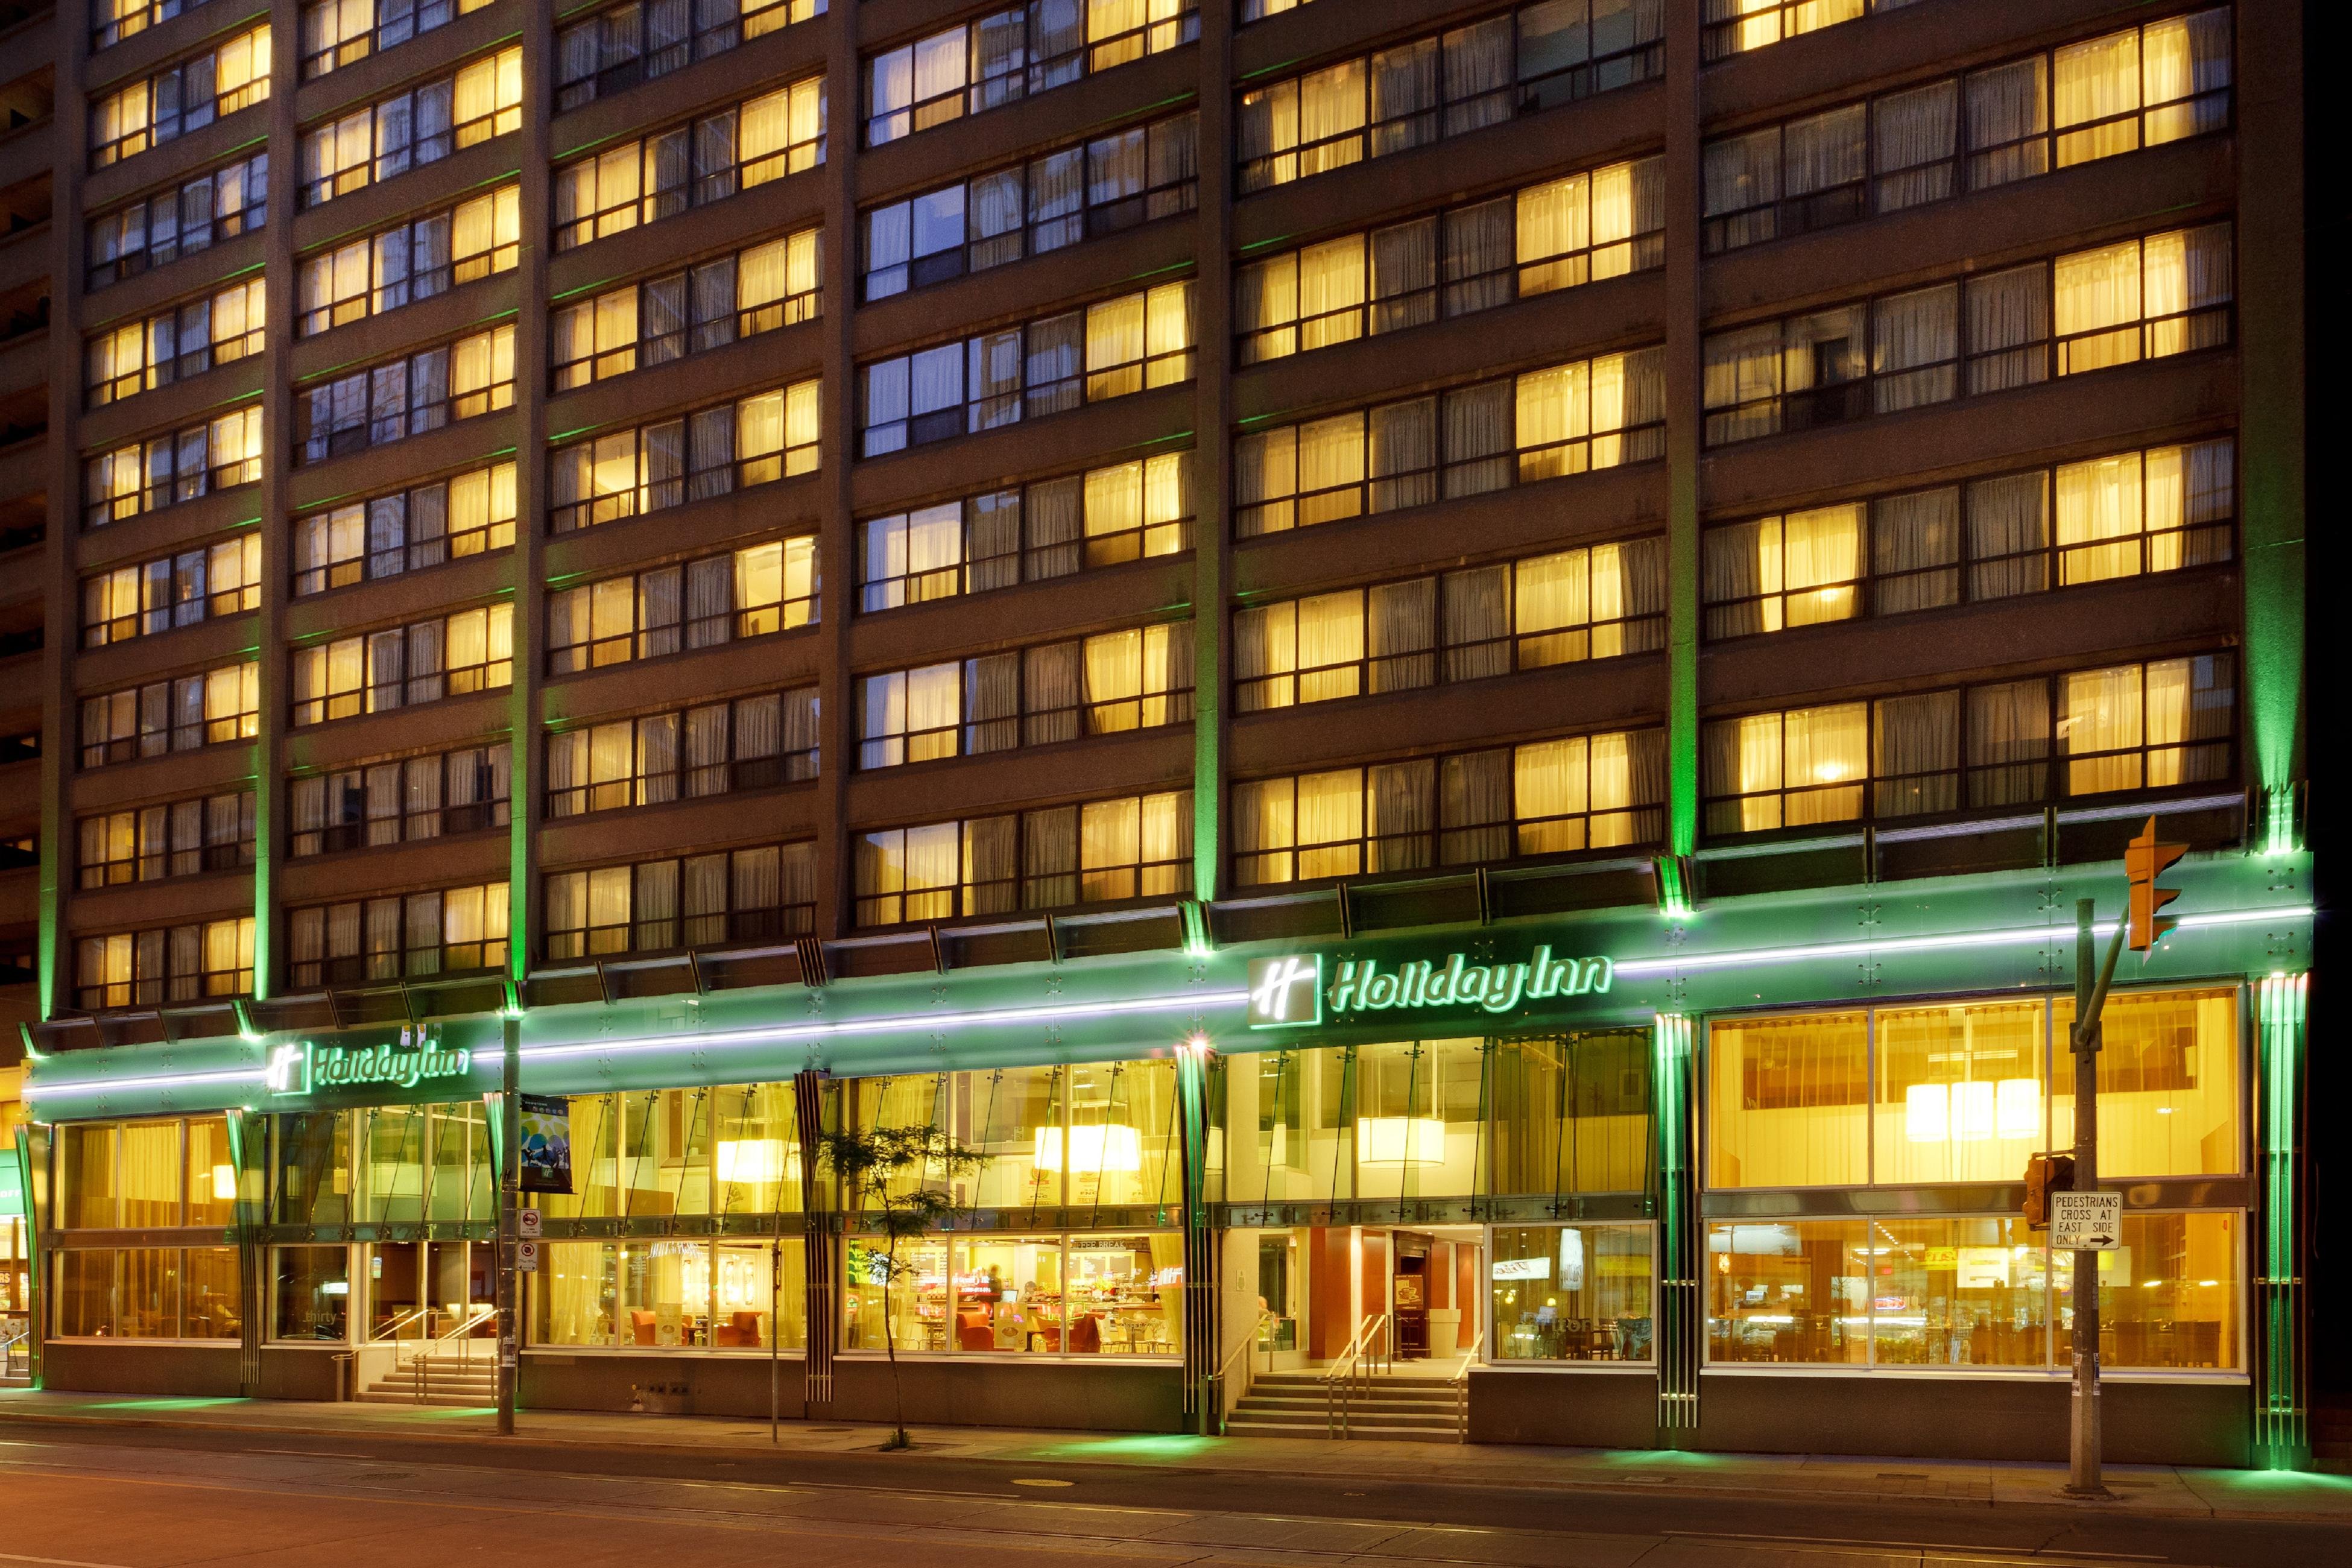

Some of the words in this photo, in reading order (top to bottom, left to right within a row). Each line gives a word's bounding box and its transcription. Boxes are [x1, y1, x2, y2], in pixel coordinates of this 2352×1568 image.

[1329, 953, 1526, 1013] Holiday
[1526, 944, 1613, 999] Inn
[312, 1045, 420, 1087] Holiday
[416, 1040, 469, 1078] Inn
[2056, 1197, 2117, 1207] PEDESTRIANS
[2061, 1209, 2091, 1220] CROSS
[2100, 1209, 2112, 1220] AT
[2059, 1222, 2082, 1232] EAST
[2093, 1222, 2113, 1233] SIDE
[1099, 1240, 1125, 1248] BREAK
[2056, 1234, 2080, 1245] ONLY
[306, 1309, 337, 1326] thirty
